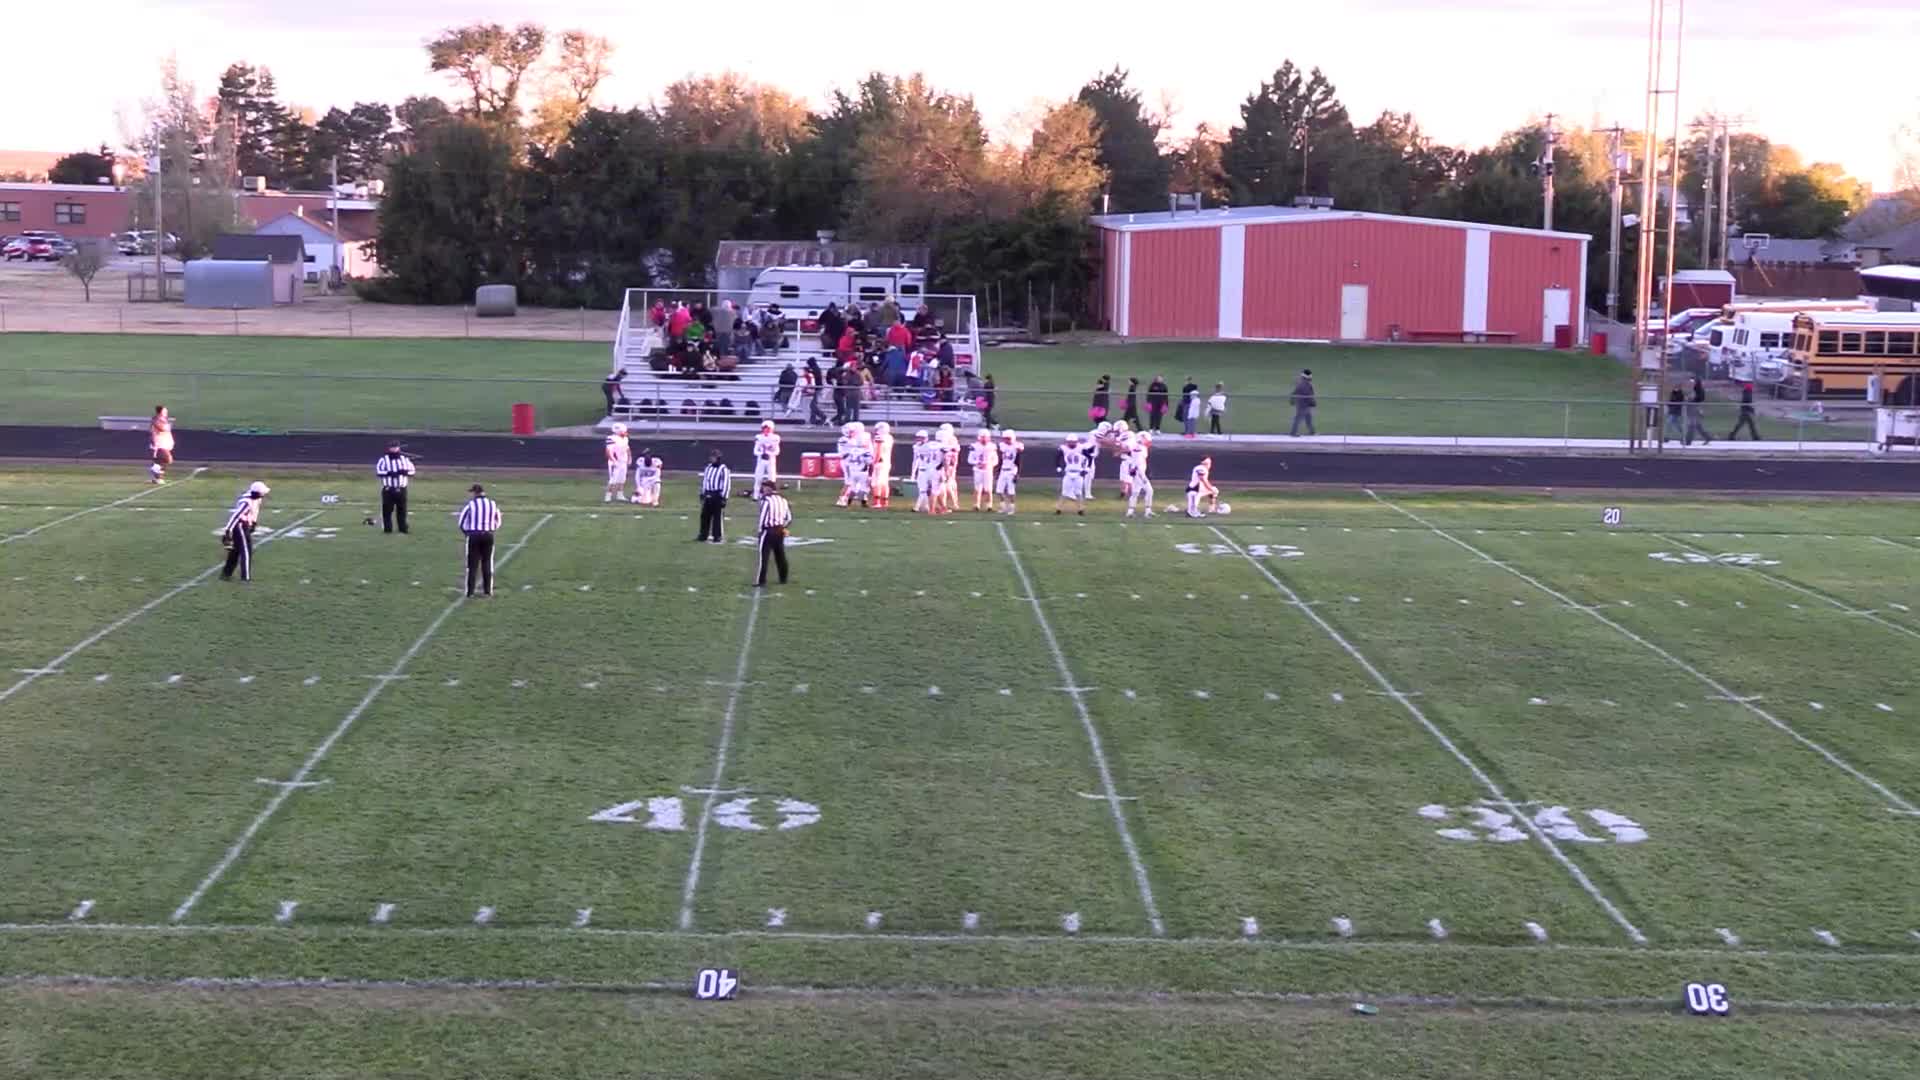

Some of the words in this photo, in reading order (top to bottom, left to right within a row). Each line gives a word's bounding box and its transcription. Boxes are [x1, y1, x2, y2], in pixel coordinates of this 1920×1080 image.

[1603, 507, 1620, 525] 20
[588, 796, 822, 831] 40
[1417, 805, 1649, 844] 30
[698, 969, 737, 998] 40
[1687, 983, 1729, 1012] 30
